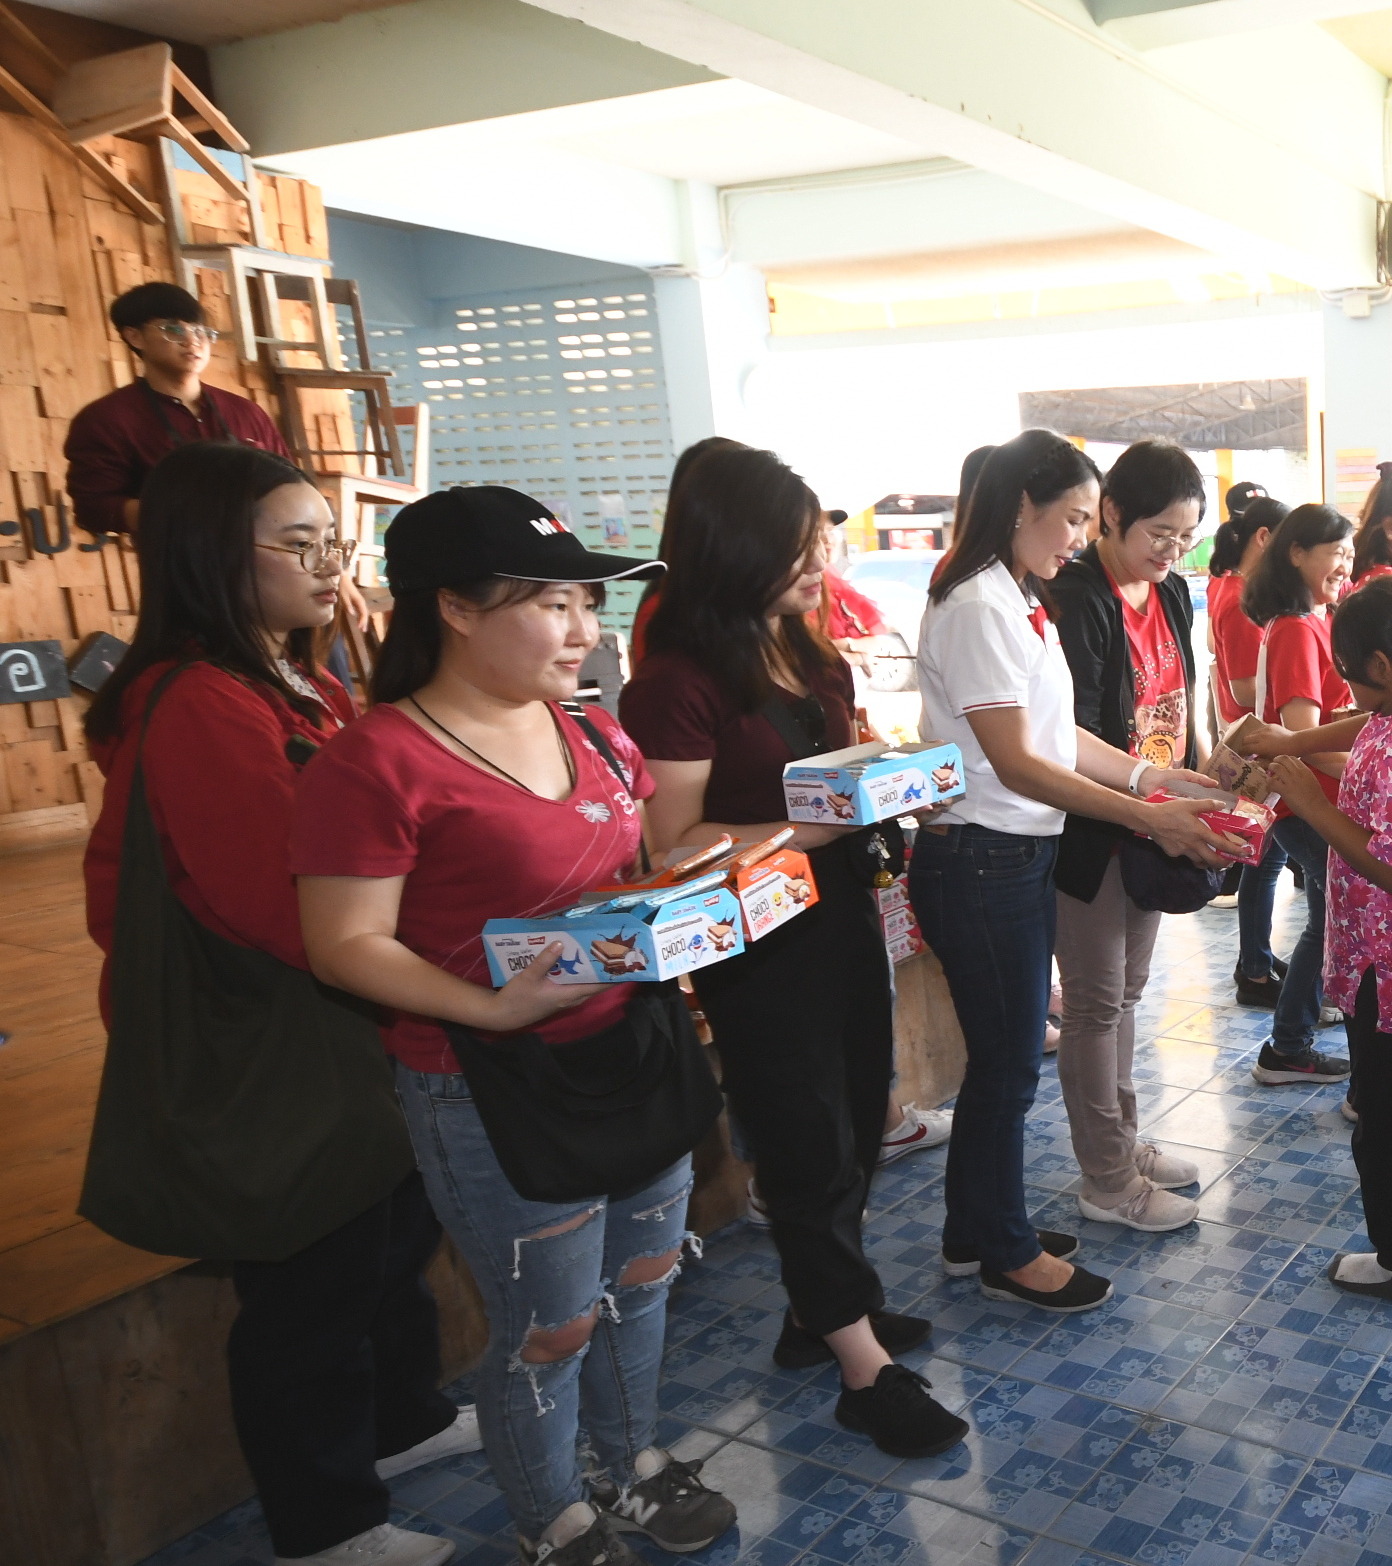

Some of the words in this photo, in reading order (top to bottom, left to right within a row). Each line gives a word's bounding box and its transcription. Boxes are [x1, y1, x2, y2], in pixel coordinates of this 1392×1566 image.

[789, 796, 809, 808] CHOCO
[878, 789, 898, 807] CHOCO
[750, 898, 770, 922] CHOCO
[662, 938, 686, 961] CHOCO
